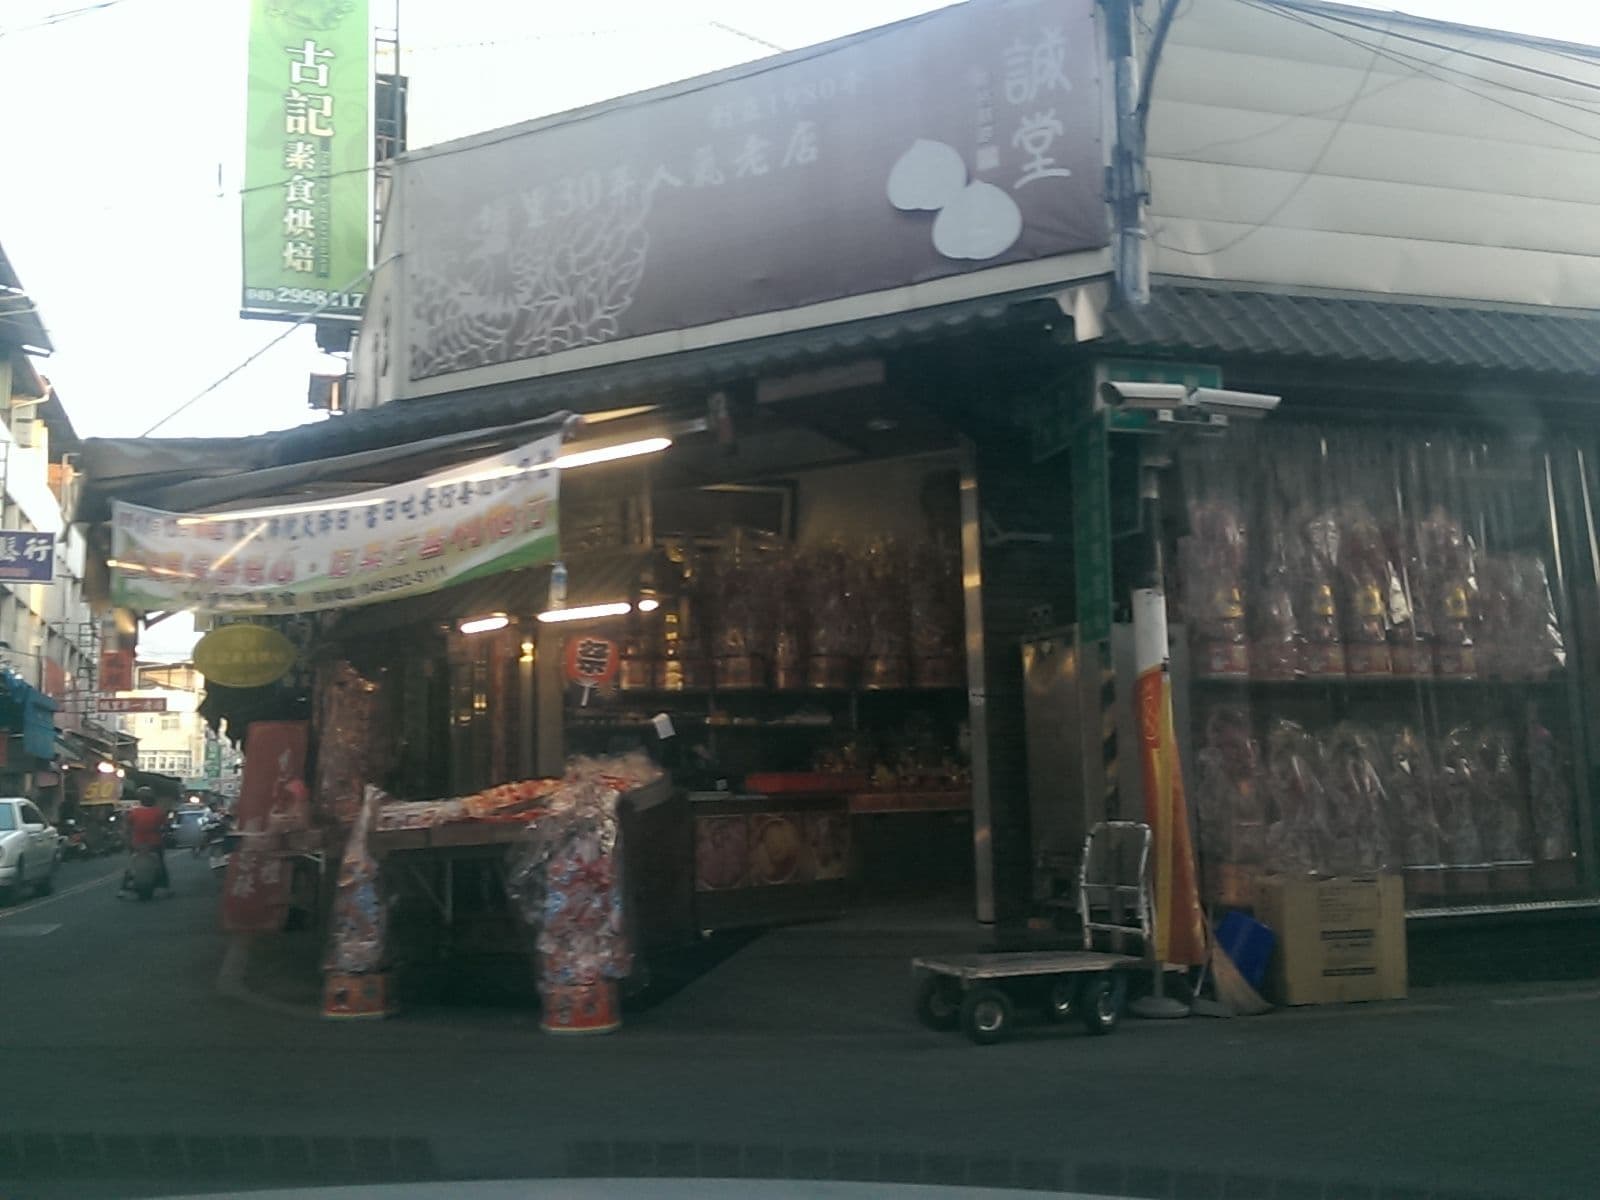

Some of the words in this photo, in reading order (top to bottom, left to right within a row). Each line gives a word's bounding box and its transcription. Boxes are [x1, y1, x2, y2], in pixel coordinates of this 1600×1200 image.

[285, 39, 336, 137] 古記
[283, 141, 316, 273] 素食烘焙
